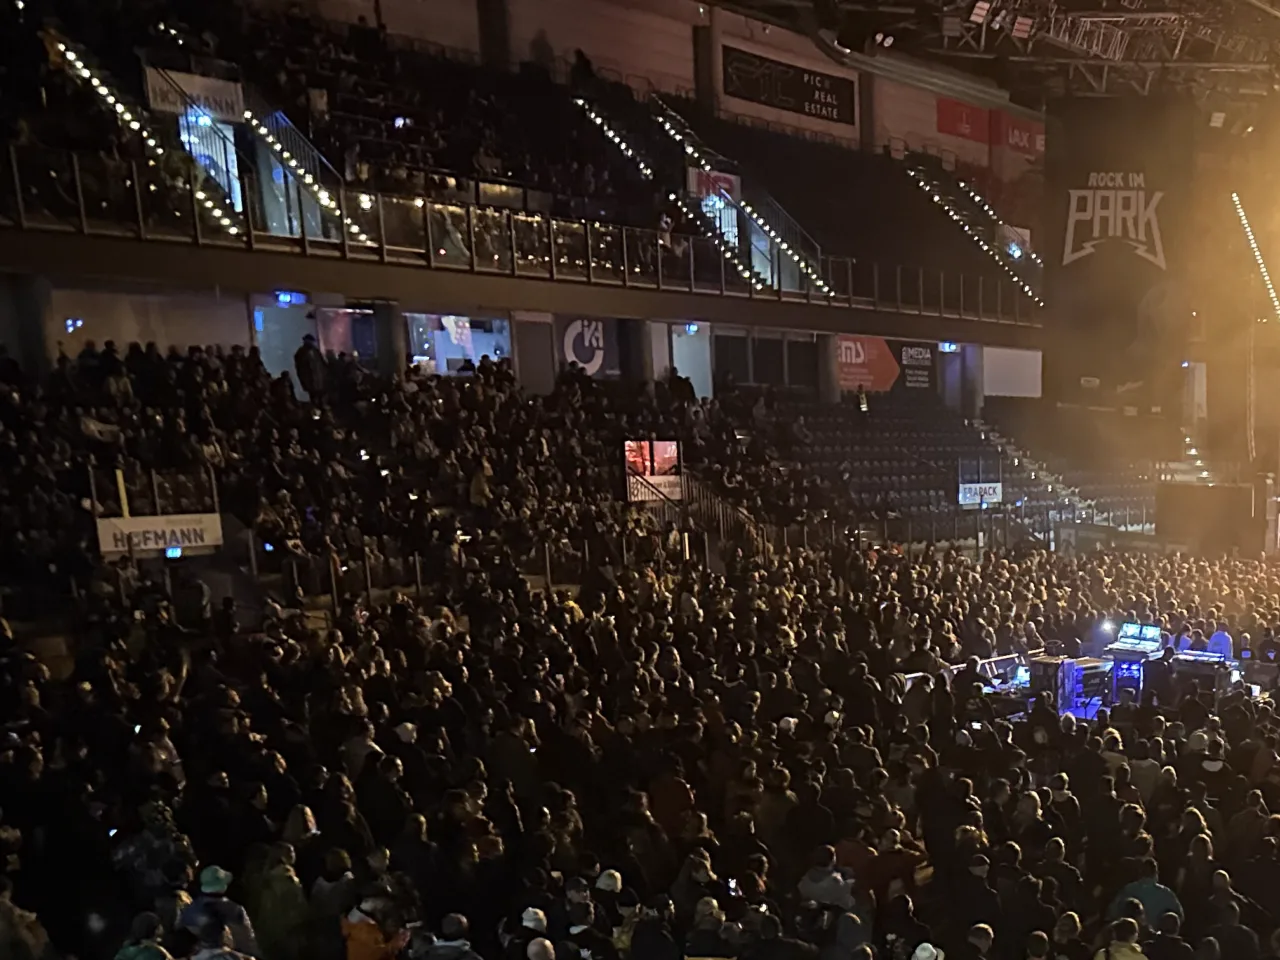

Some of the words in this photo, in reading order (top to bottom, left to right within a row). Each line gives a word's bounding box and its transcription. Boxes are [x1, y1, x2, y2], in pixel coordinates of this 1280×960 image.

[814, 90, 838, 105] REAL
[804, 102, 838, 119] ESTATE
[1088, 172, 1124, 187] ROCK
[1128, 172, 1145, 187] IM
[1062, 189, 1167, 271] PARK
